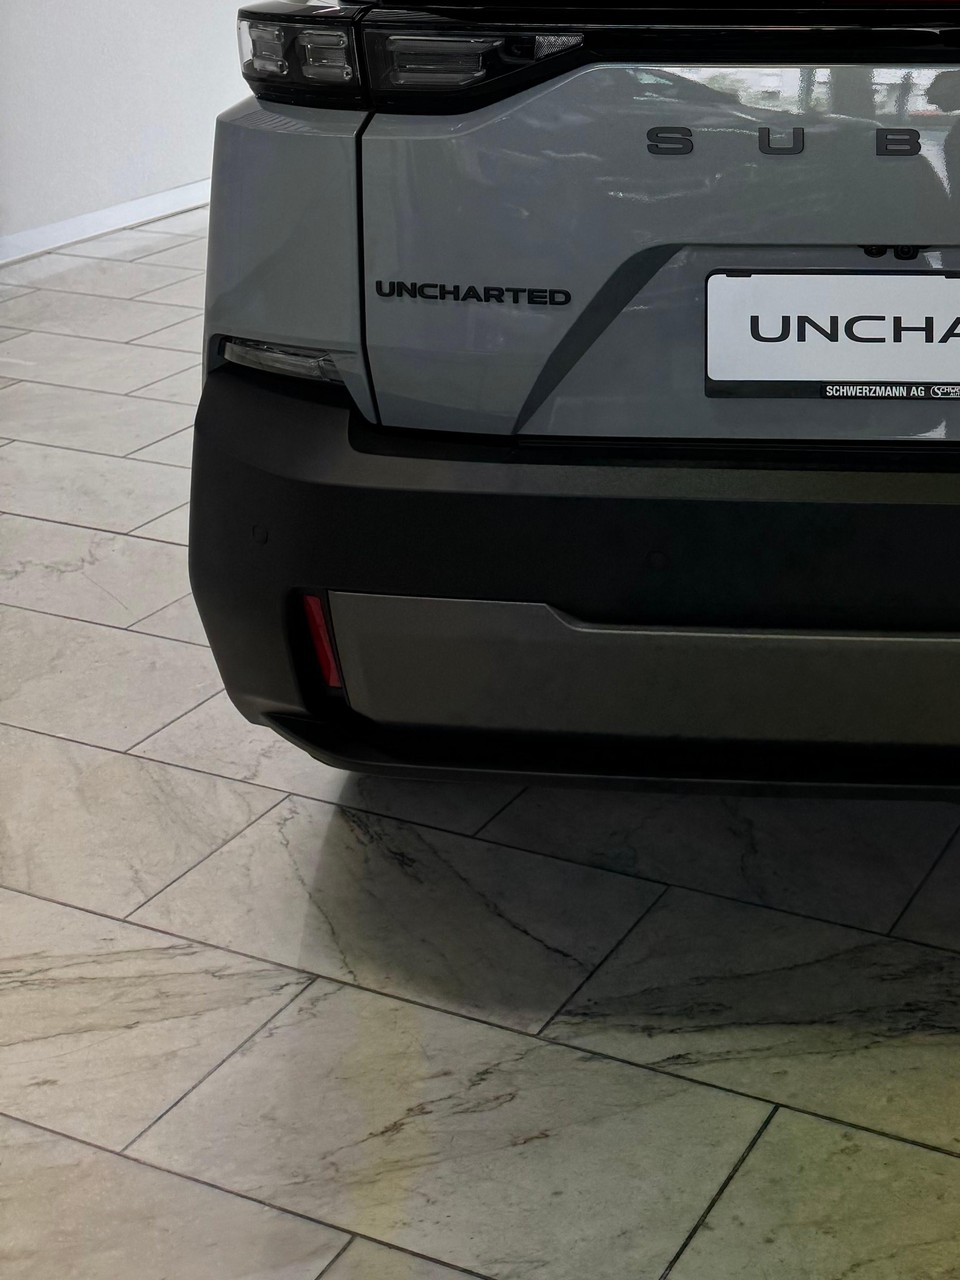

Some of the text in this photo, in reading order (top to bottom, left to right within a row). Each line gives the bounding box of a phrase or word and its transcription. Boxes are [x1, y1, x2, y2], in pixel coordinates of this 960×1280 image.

[375, 280, 572, 306] UNCHARTED
[826, 386, 925, 398] SCHWERZMANN AG
